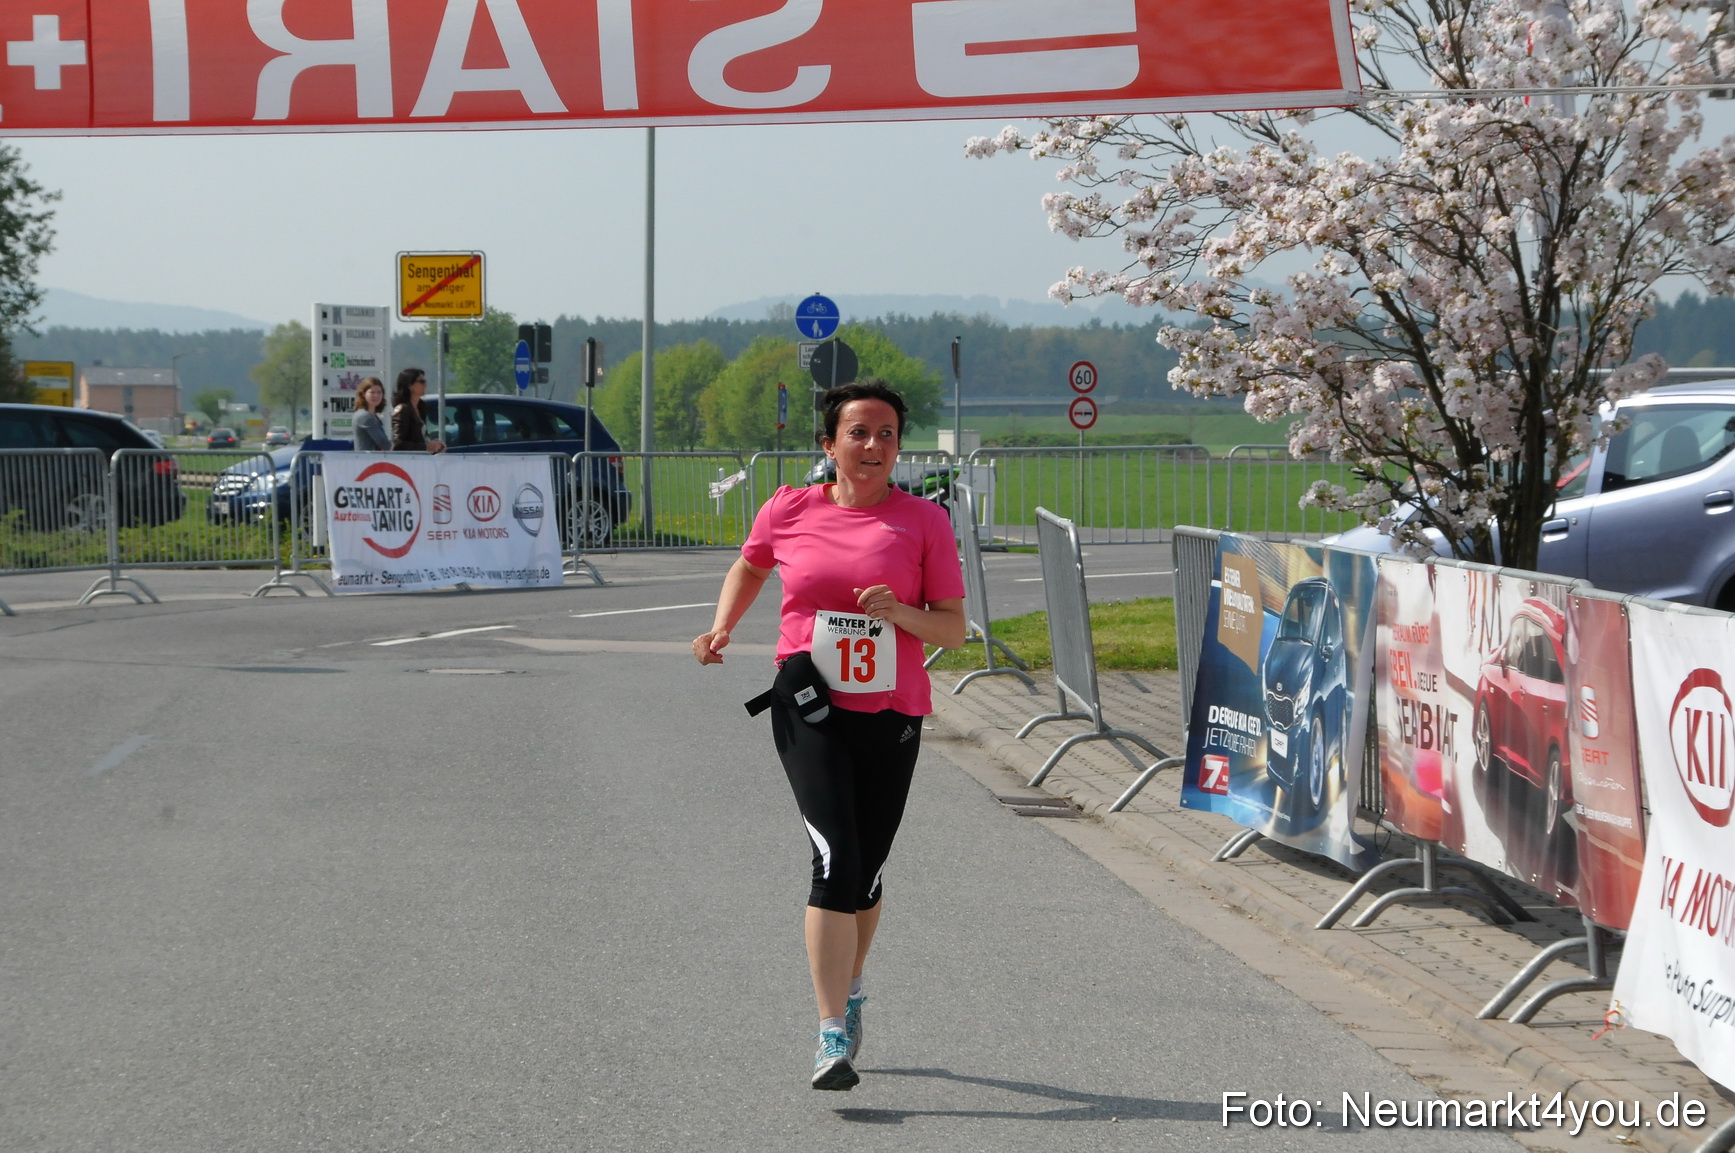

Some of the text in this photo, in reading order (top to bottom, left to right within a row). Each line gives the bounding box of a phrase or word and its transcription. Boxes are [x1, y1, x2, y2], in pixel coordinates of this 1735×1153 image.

[408, 263, 475, 282] Sengenthal
[1075, 370, 1091, 385] 60
[334, 486, 403, 509] GERHART
[472, 495, 495, 513] KIA
[514, 505, 542, 516] NISSA
[427, 530, 458, 540] SEAT
[477, 527, 509, 539] MOTORS
[828, 617, 866, 629] MEYER
[827, 626, 866, 636] WERBUNG
[836, 637, 876, 683] 13
[1202, 760, 1224, 789] 7
